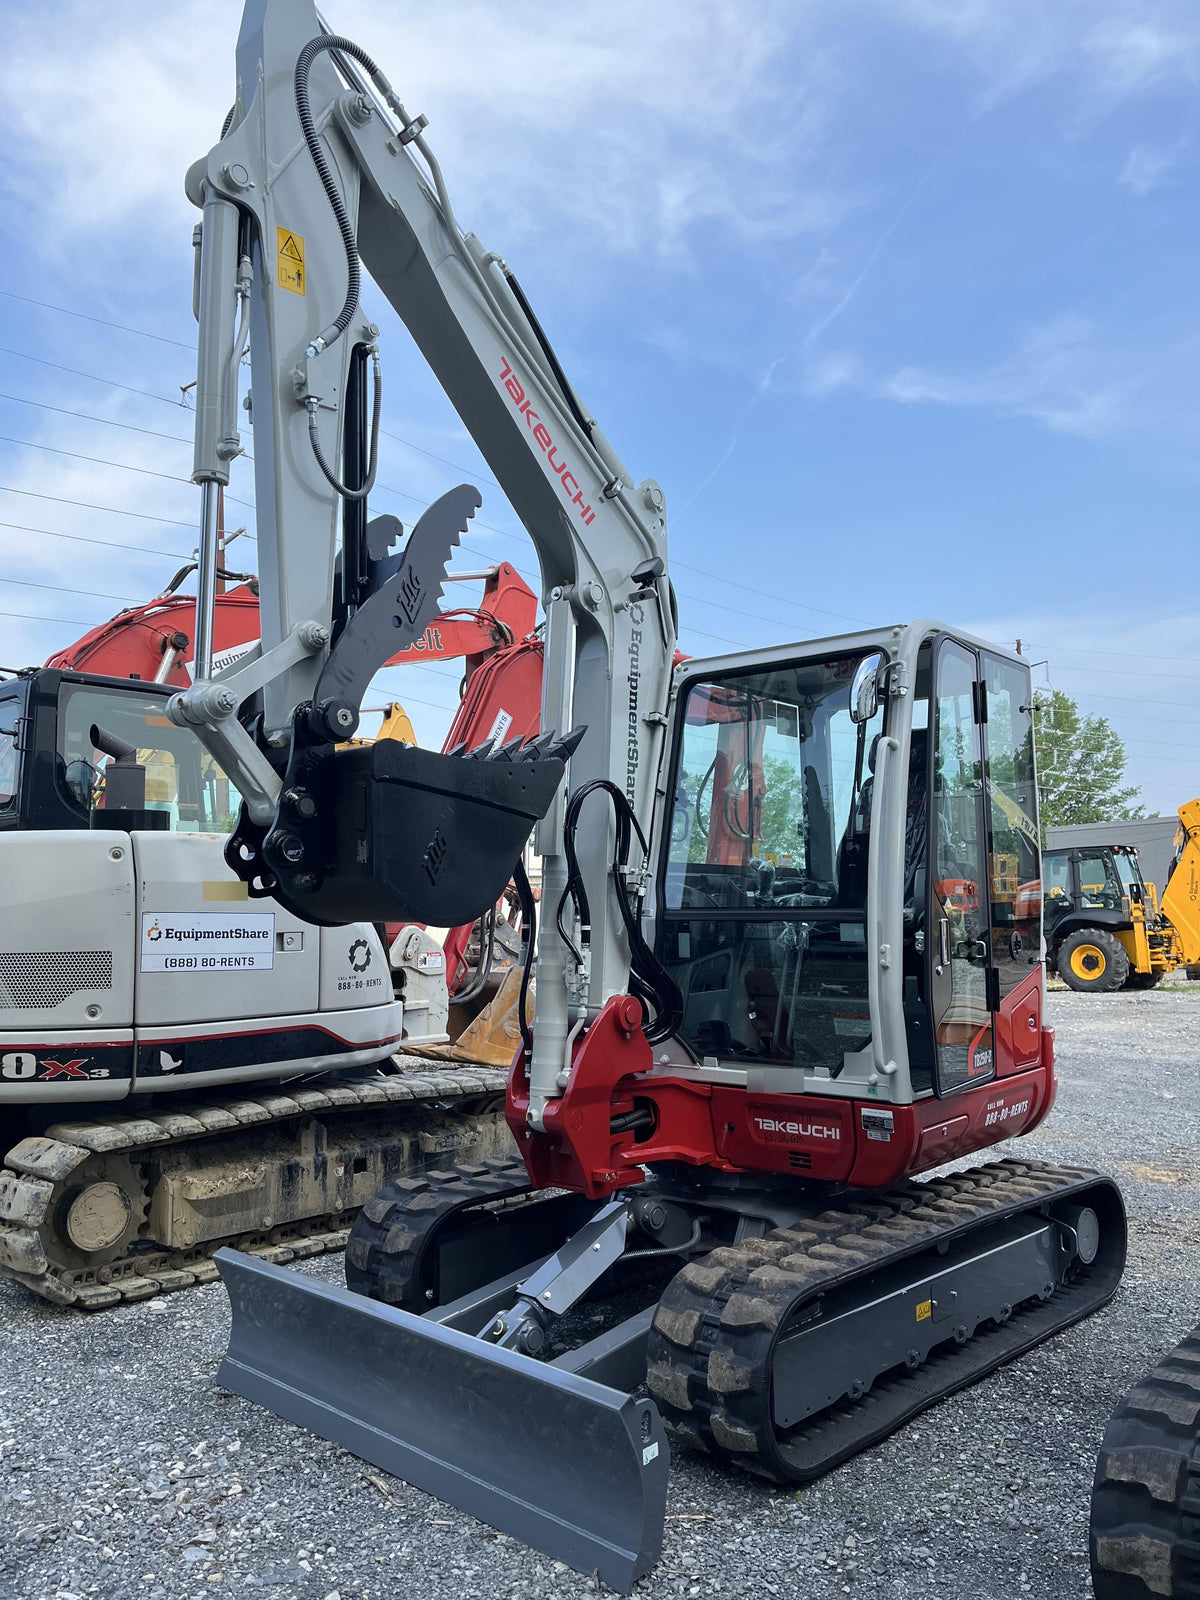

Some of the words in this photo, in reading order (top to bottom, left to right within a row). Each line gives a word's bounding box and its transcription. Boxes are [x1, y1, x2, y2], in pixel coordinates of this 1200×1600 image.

[499, 356, 597, 526] TAKEUCHI
[402, 627, 444, 651] elt
[165, 928, 269, 942] EquipmentShare
[164, 957, 198, 969] (888)
[201, 957, 255, 967] 80-RENTS
[337, 977, 382, 991] 888-80-RENTS
[984, 1100, 1029, 1126] 888-80-RENTS
[987, 1101, 996, 1110] CALL
[754, 1117, 840, 1140] TAKEUCHI
